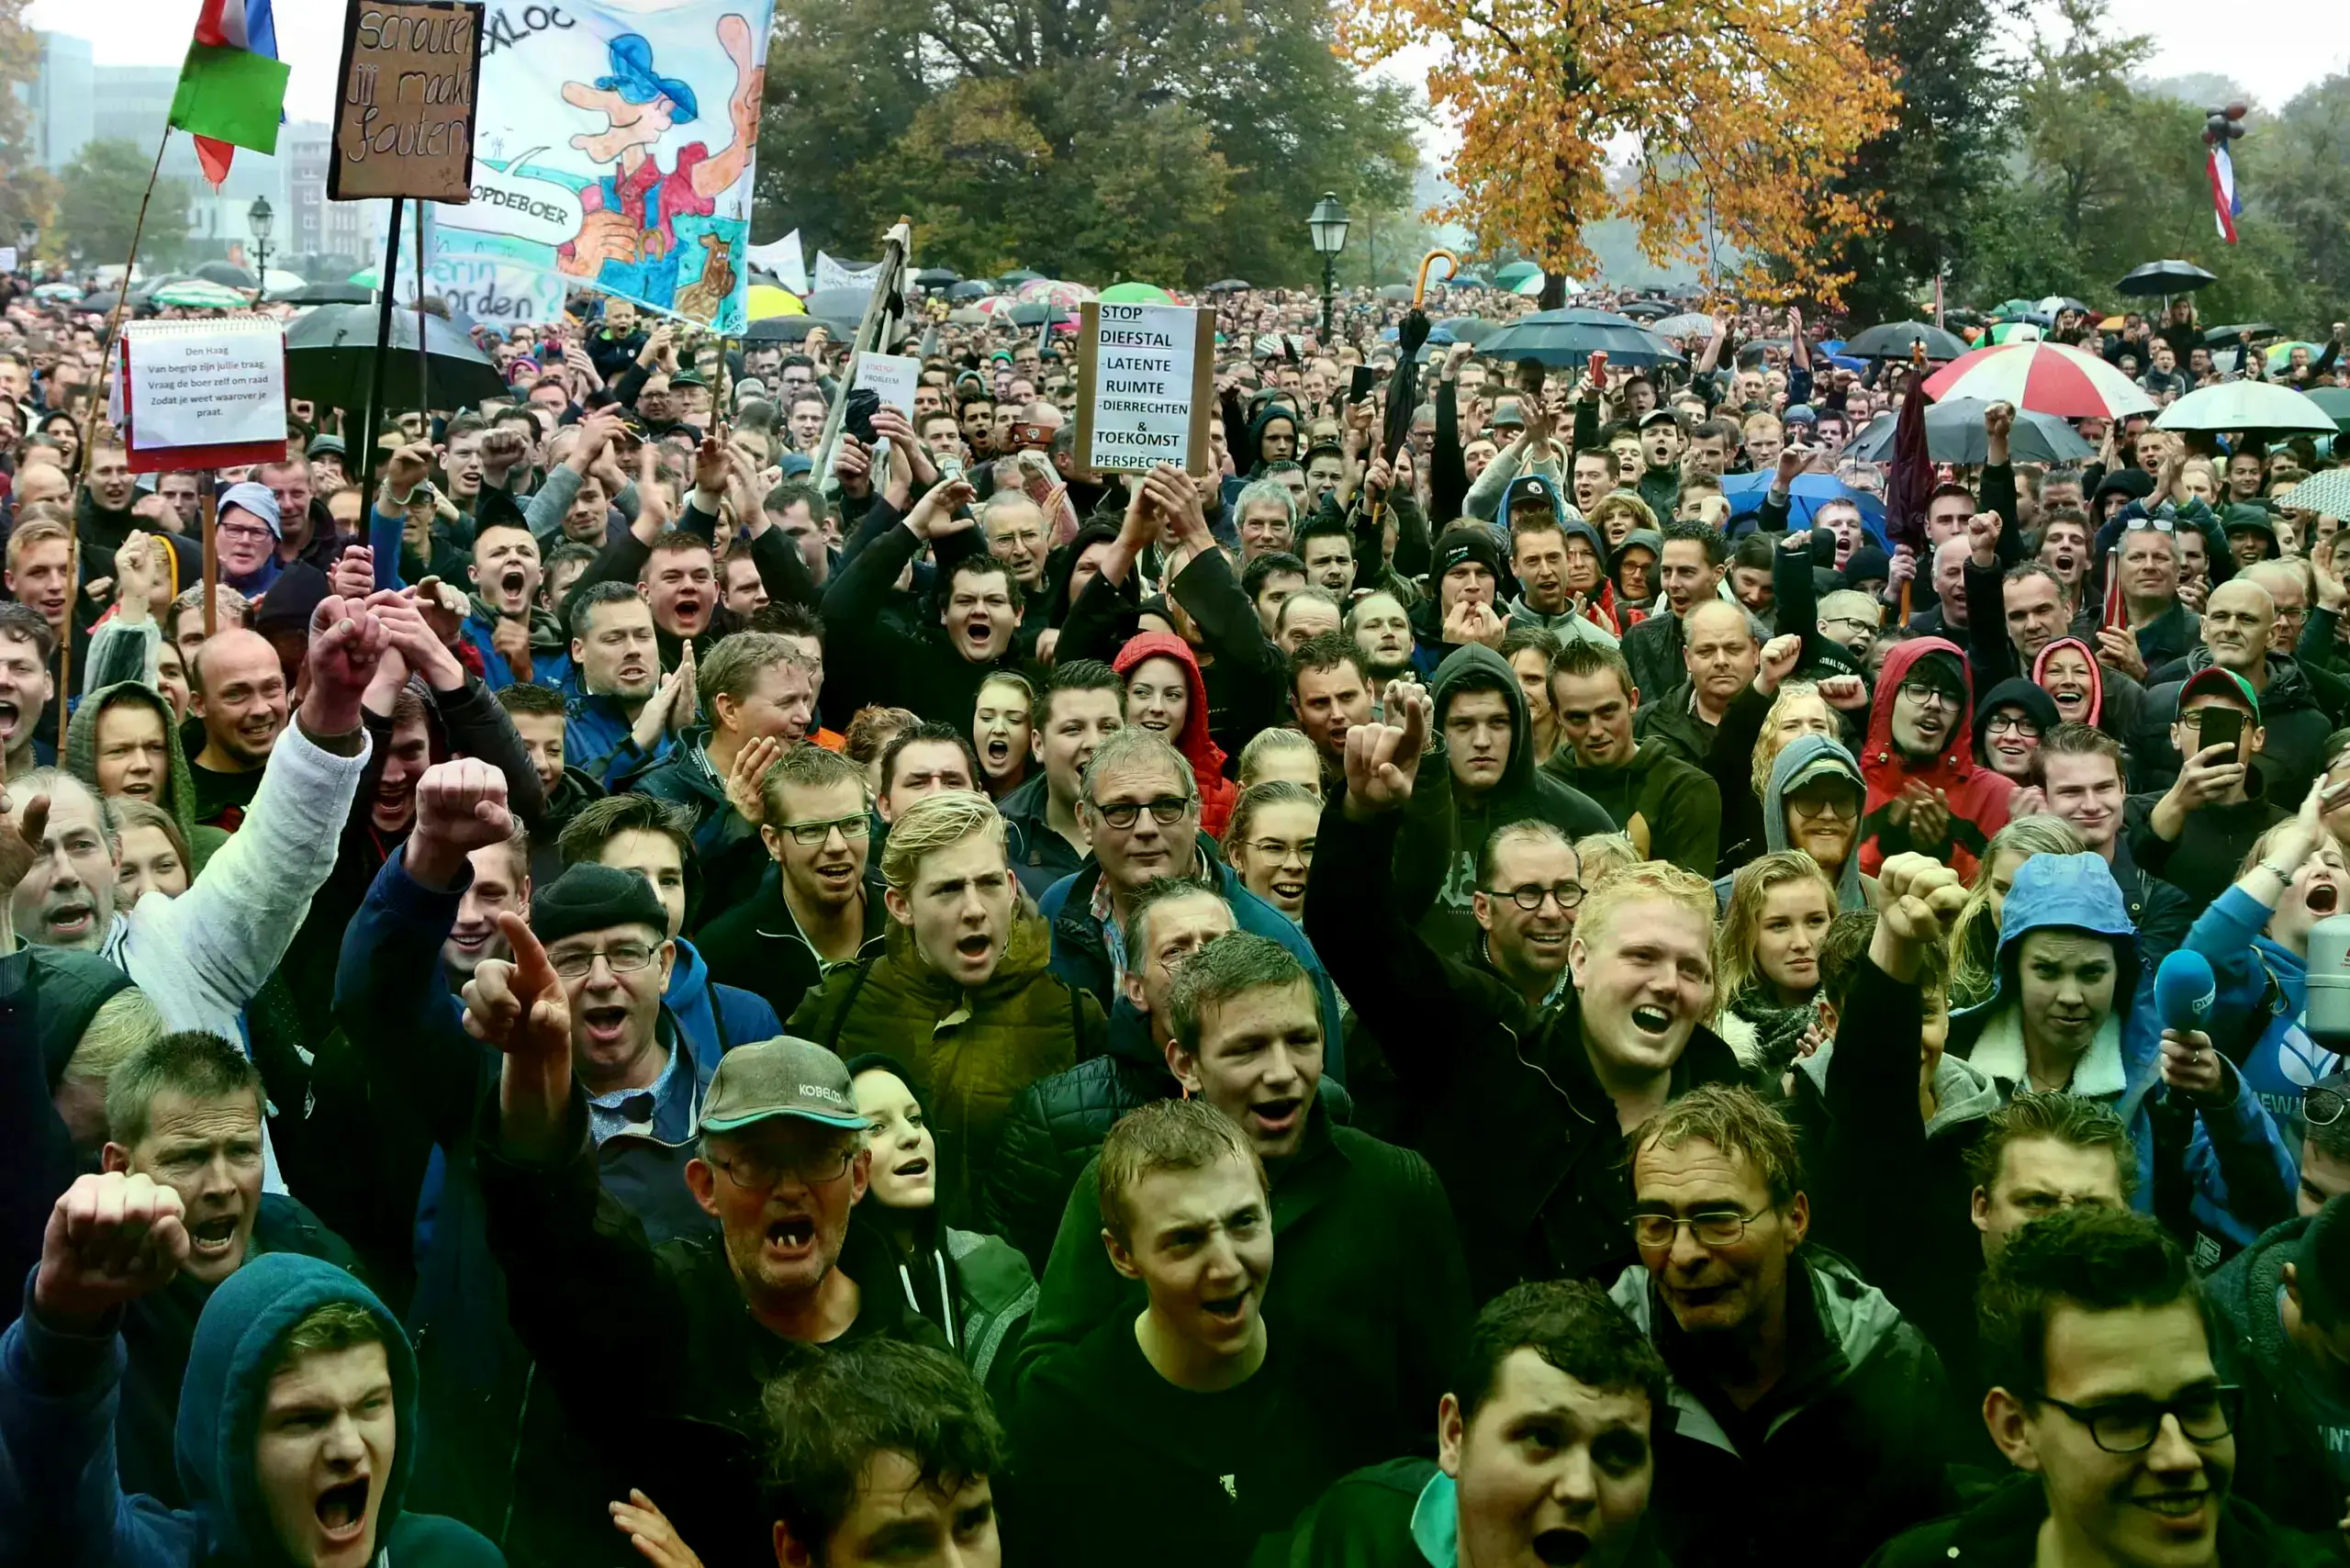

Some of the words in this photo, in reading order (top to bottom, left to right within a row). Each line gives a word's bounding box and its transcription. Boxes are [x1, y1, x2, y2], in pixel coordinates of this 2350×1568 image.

[347, 63, 378, 106] jij
[347, 106, 466, 162] fouten
[1102, 306, 1143, 320] STOP
[1100, 330, 1172, 347] DIEFSTAL
[185, 347, 204, 356] Den
[206, 346, 229, 356] Haag
[148, 364, 166, 374] Van
[168, 364, 197, 374] begrip
[199, 362, 216, 373] zijn
[217, 361, 239, 372] jullie
[148, 381, 174, 390] Vraag
[177, 379, 189, 388] de
[191, 378, 211, 387] boer
[213, 376, 230, 386] zelf
[248, 375, 269, 385] raad
[1105, 379, 1165, 395] RUIMTE
[151, 396, 177, 405] Zodat
[179, 394, 188, 405] je
[190, 394, 212, 403] weet
[215, 392, 256, 401] waarover
[258, 390, 266, 401] je
[196, 409, 223, 419] praat.
[1137, 421, 1147, 431] &
[1097, 431, 1180, 447] TOEKOMST
[1095, 454, 1182, 468] PERSPECEF
